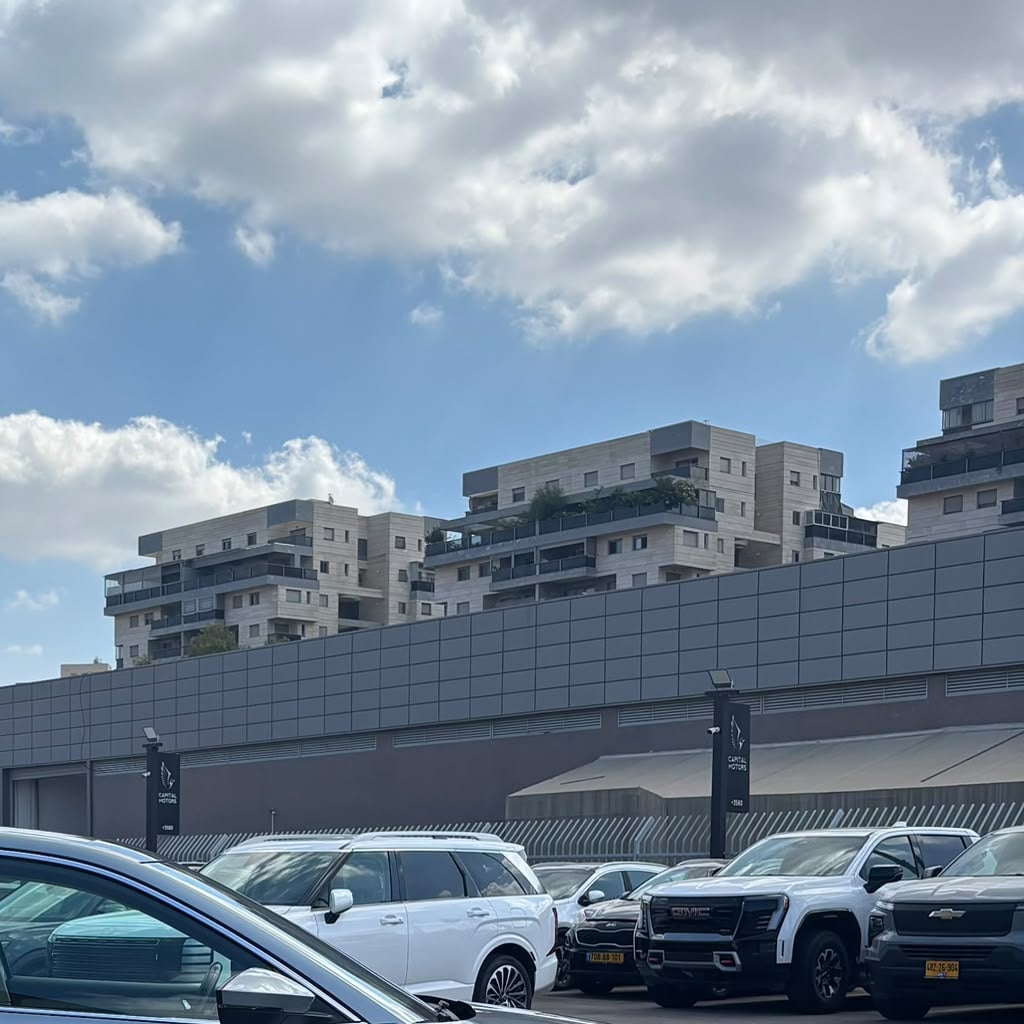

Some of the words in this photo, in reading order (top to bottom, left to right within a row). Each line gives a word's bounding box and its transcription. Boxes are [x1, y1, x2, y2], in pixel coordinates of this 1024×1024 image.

[728, 755, 747, 763] CAPITAL
[728, 763, 747, 771] MOTORS
[671, 907, 711, 917] GMC
